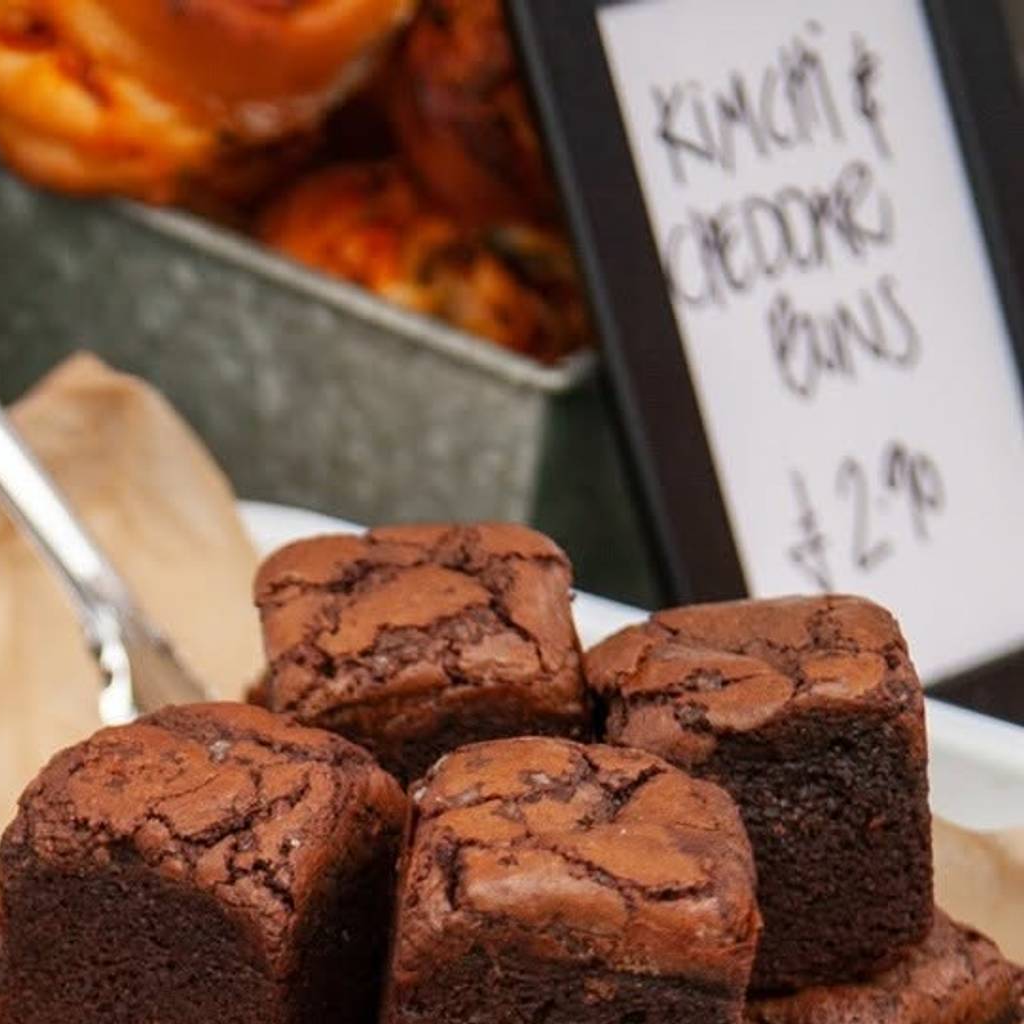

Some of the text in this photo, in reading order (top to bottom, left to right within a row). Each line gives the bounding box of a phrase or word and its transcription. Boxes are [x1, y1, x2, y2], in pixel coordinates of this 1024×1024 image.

[651, 18, 845, 184] KIMCHI
[665, 160, 895, 306] CHEDDAR
[767, 274, 921, 398] BUNS
